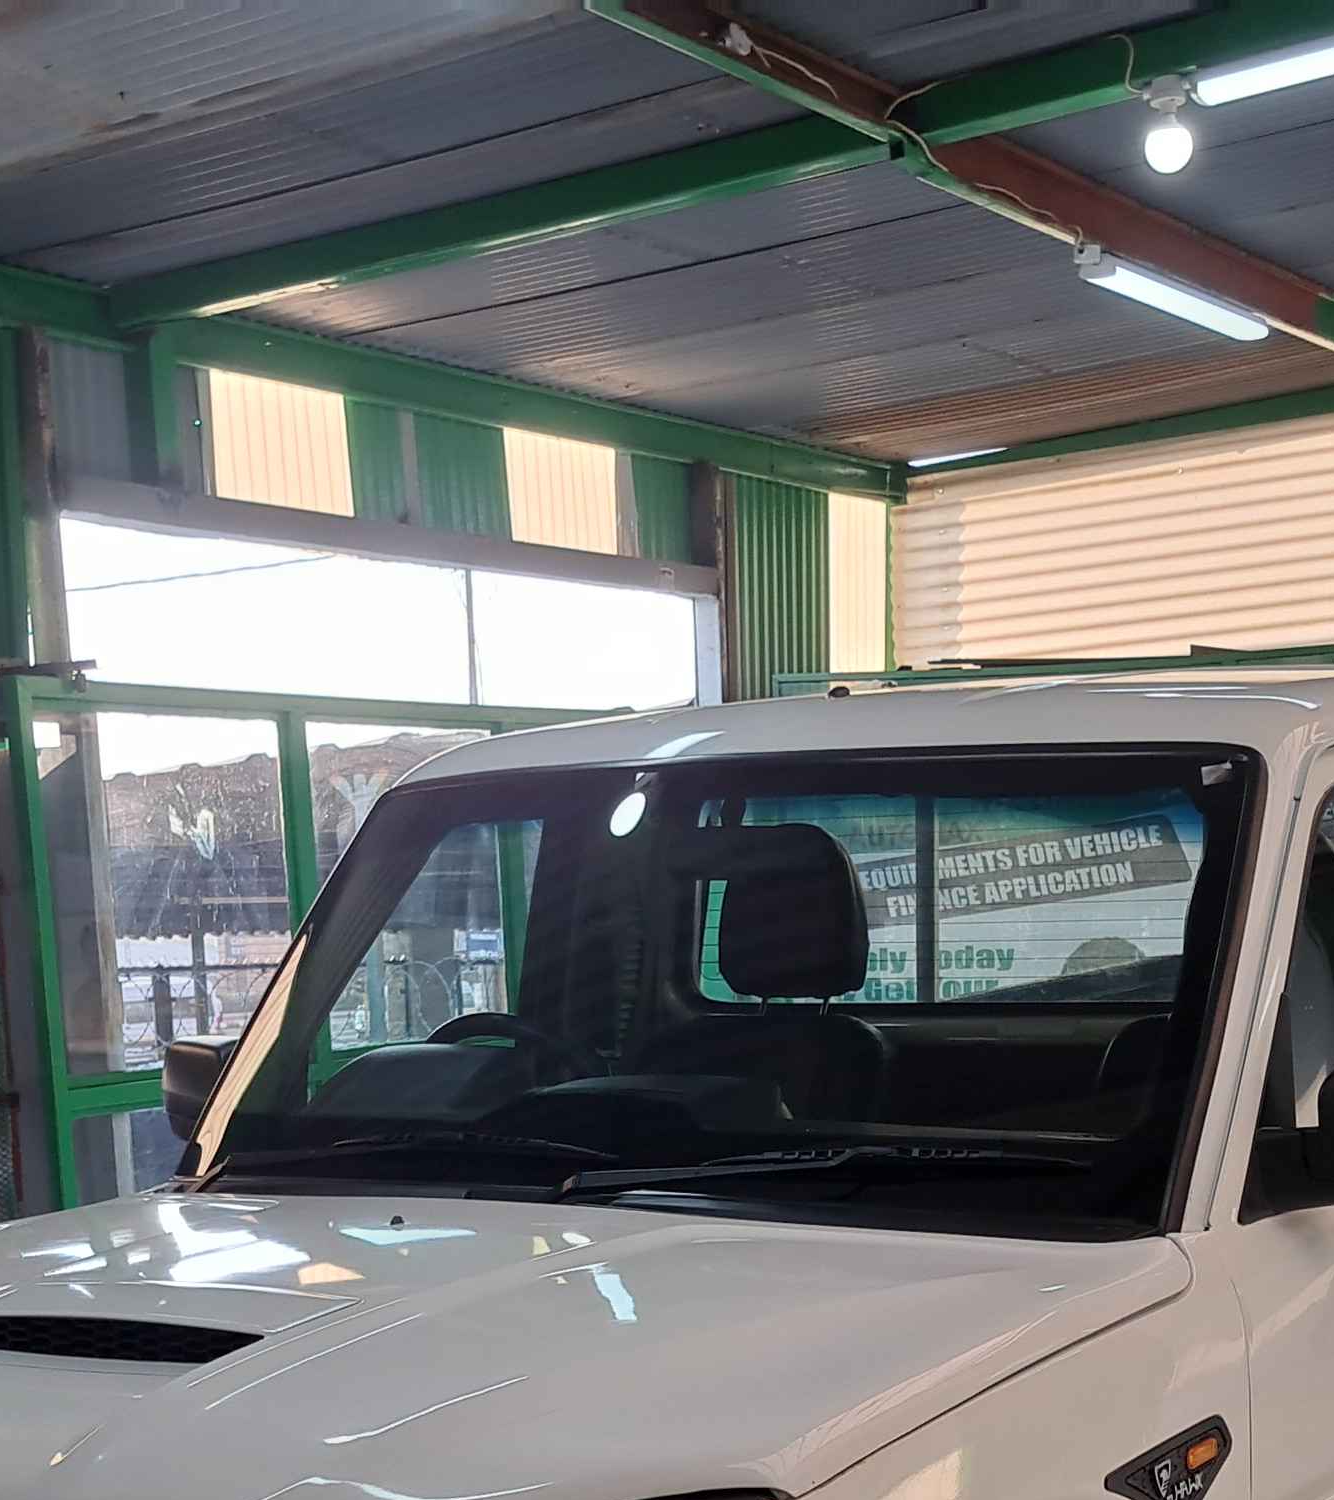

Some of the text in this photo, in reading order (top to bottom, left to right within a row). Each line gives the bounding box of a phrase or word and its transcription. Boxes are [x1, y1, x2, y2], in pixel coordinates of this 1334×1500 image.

[1015, 841, 1062, 867] FOR
[1065, 824, 1163, 858] VEHICLE
[985, 861, 1134, 904] APPLICATION
[940, 946, 1015, 971] oday
